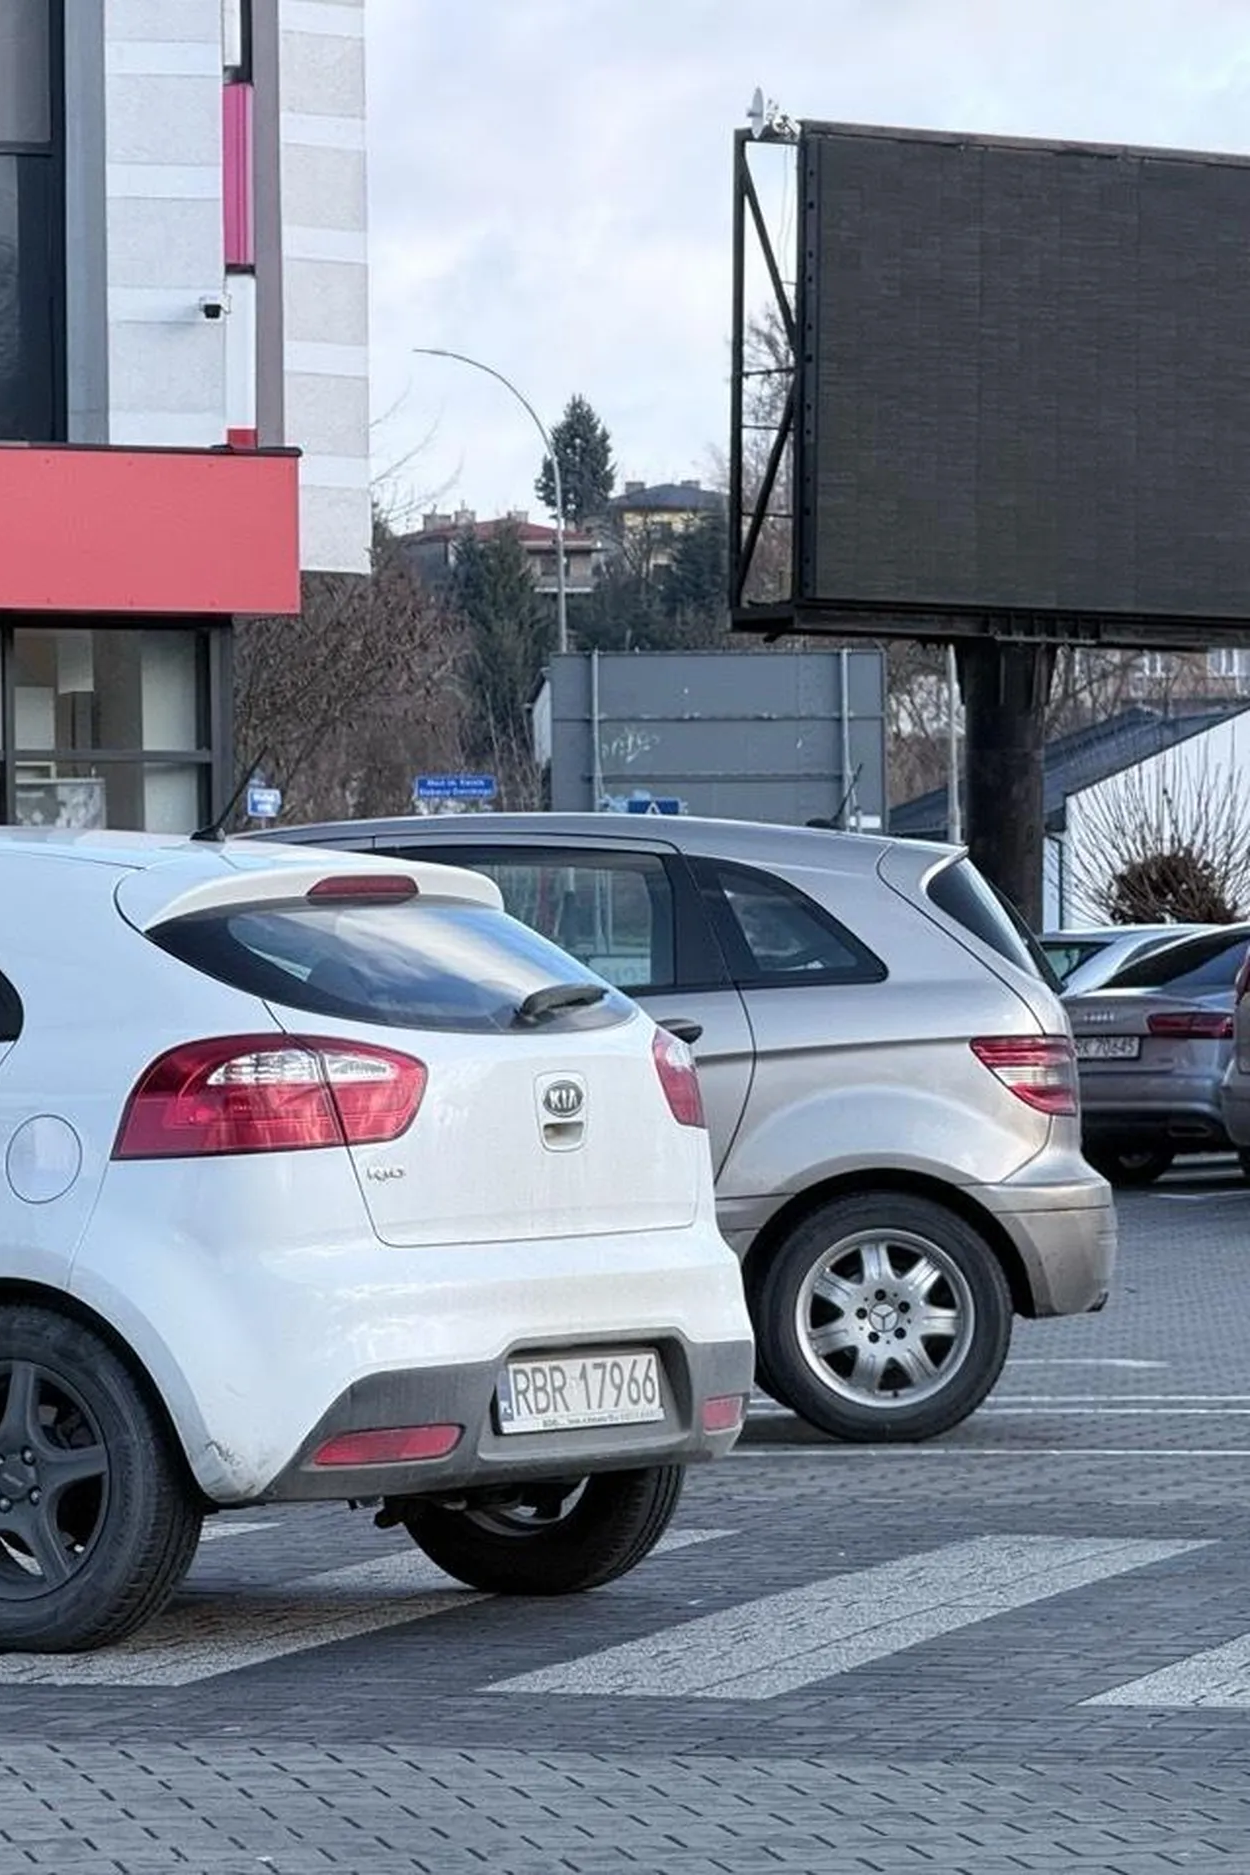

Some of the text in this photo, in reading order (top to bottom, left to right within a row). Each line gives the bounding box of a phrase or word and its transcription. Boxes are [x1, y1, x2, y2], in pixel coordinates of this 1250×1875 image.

[549, 1088, 579, 1110] KIA
[512, 1357, 656, 1417] RBR 17966
